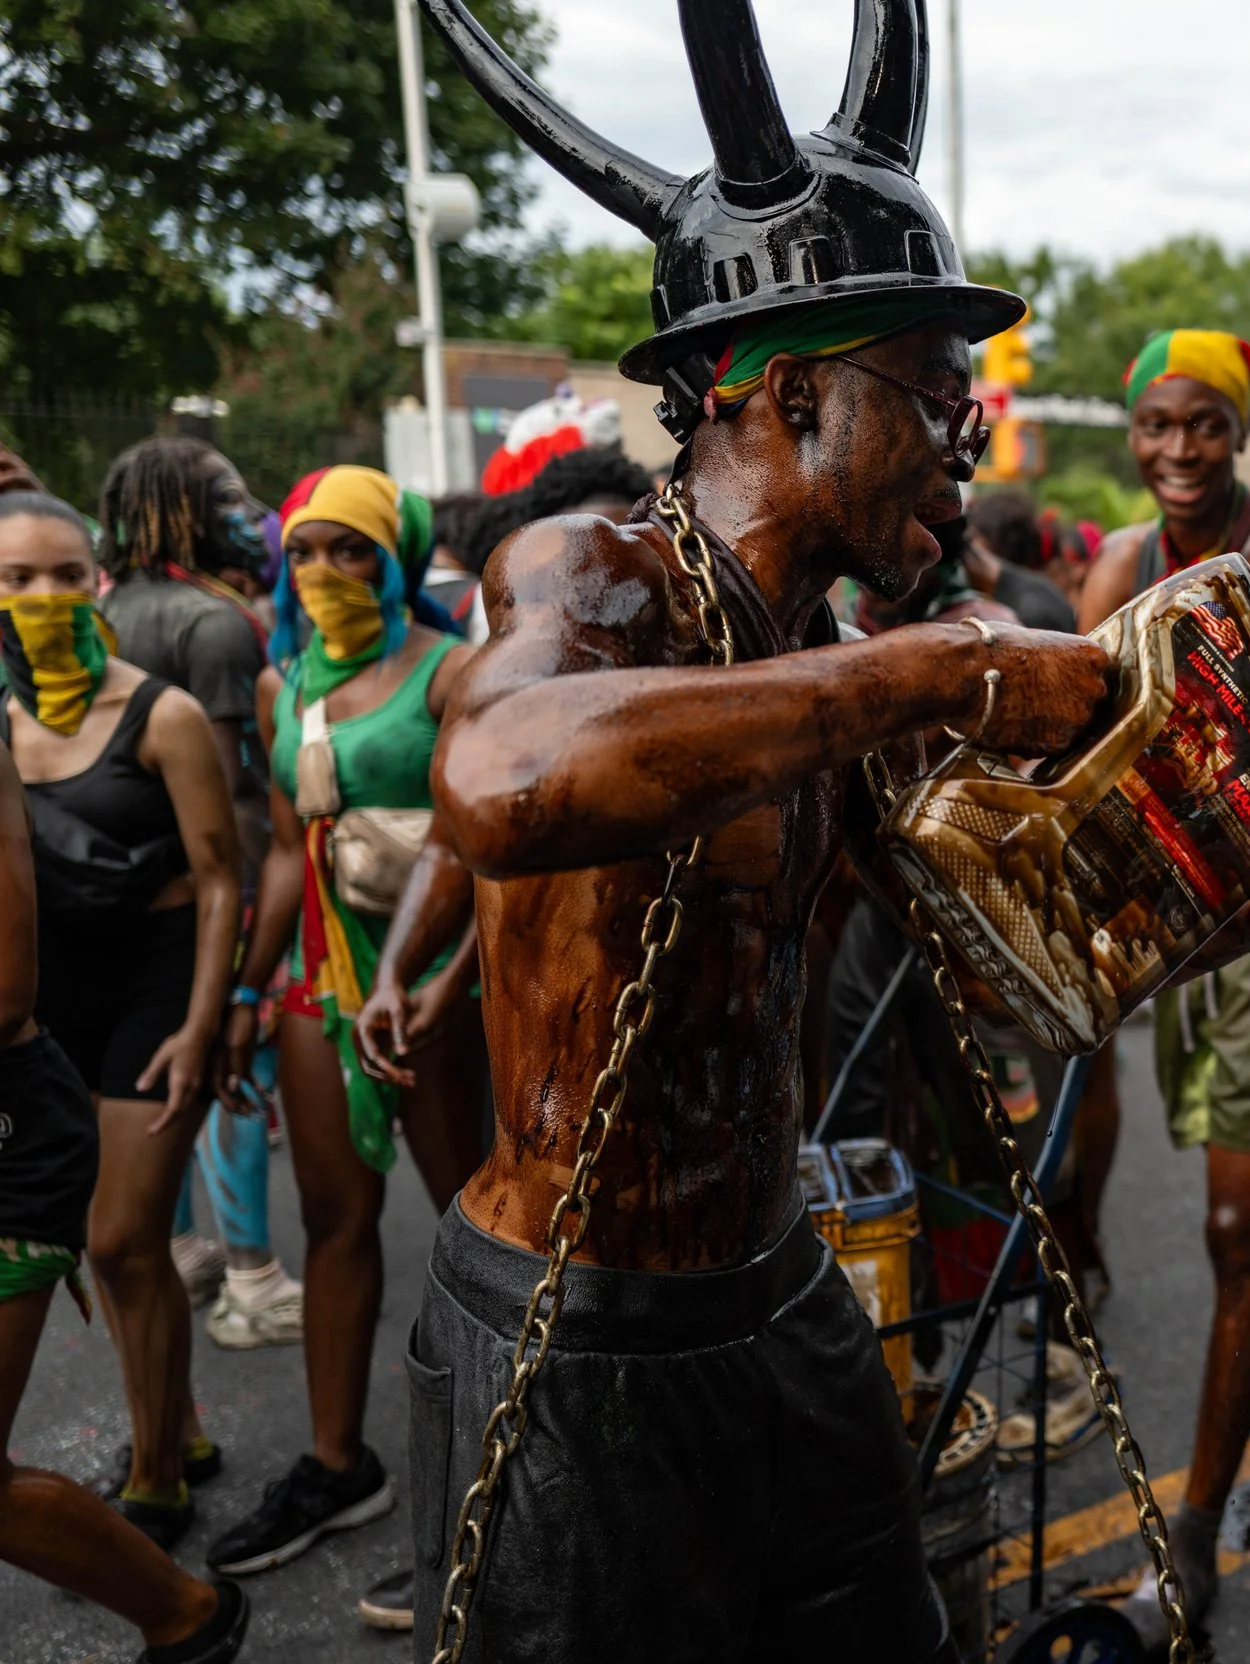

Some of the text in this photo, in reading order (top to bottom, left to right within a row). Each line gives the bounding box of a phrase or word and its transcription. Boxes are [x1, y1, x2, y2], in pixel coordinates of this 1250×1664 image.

[1187, 650, 1219, 686] HIGH
[1198, 645, 1249, 705] FULL SYNTHETIC
